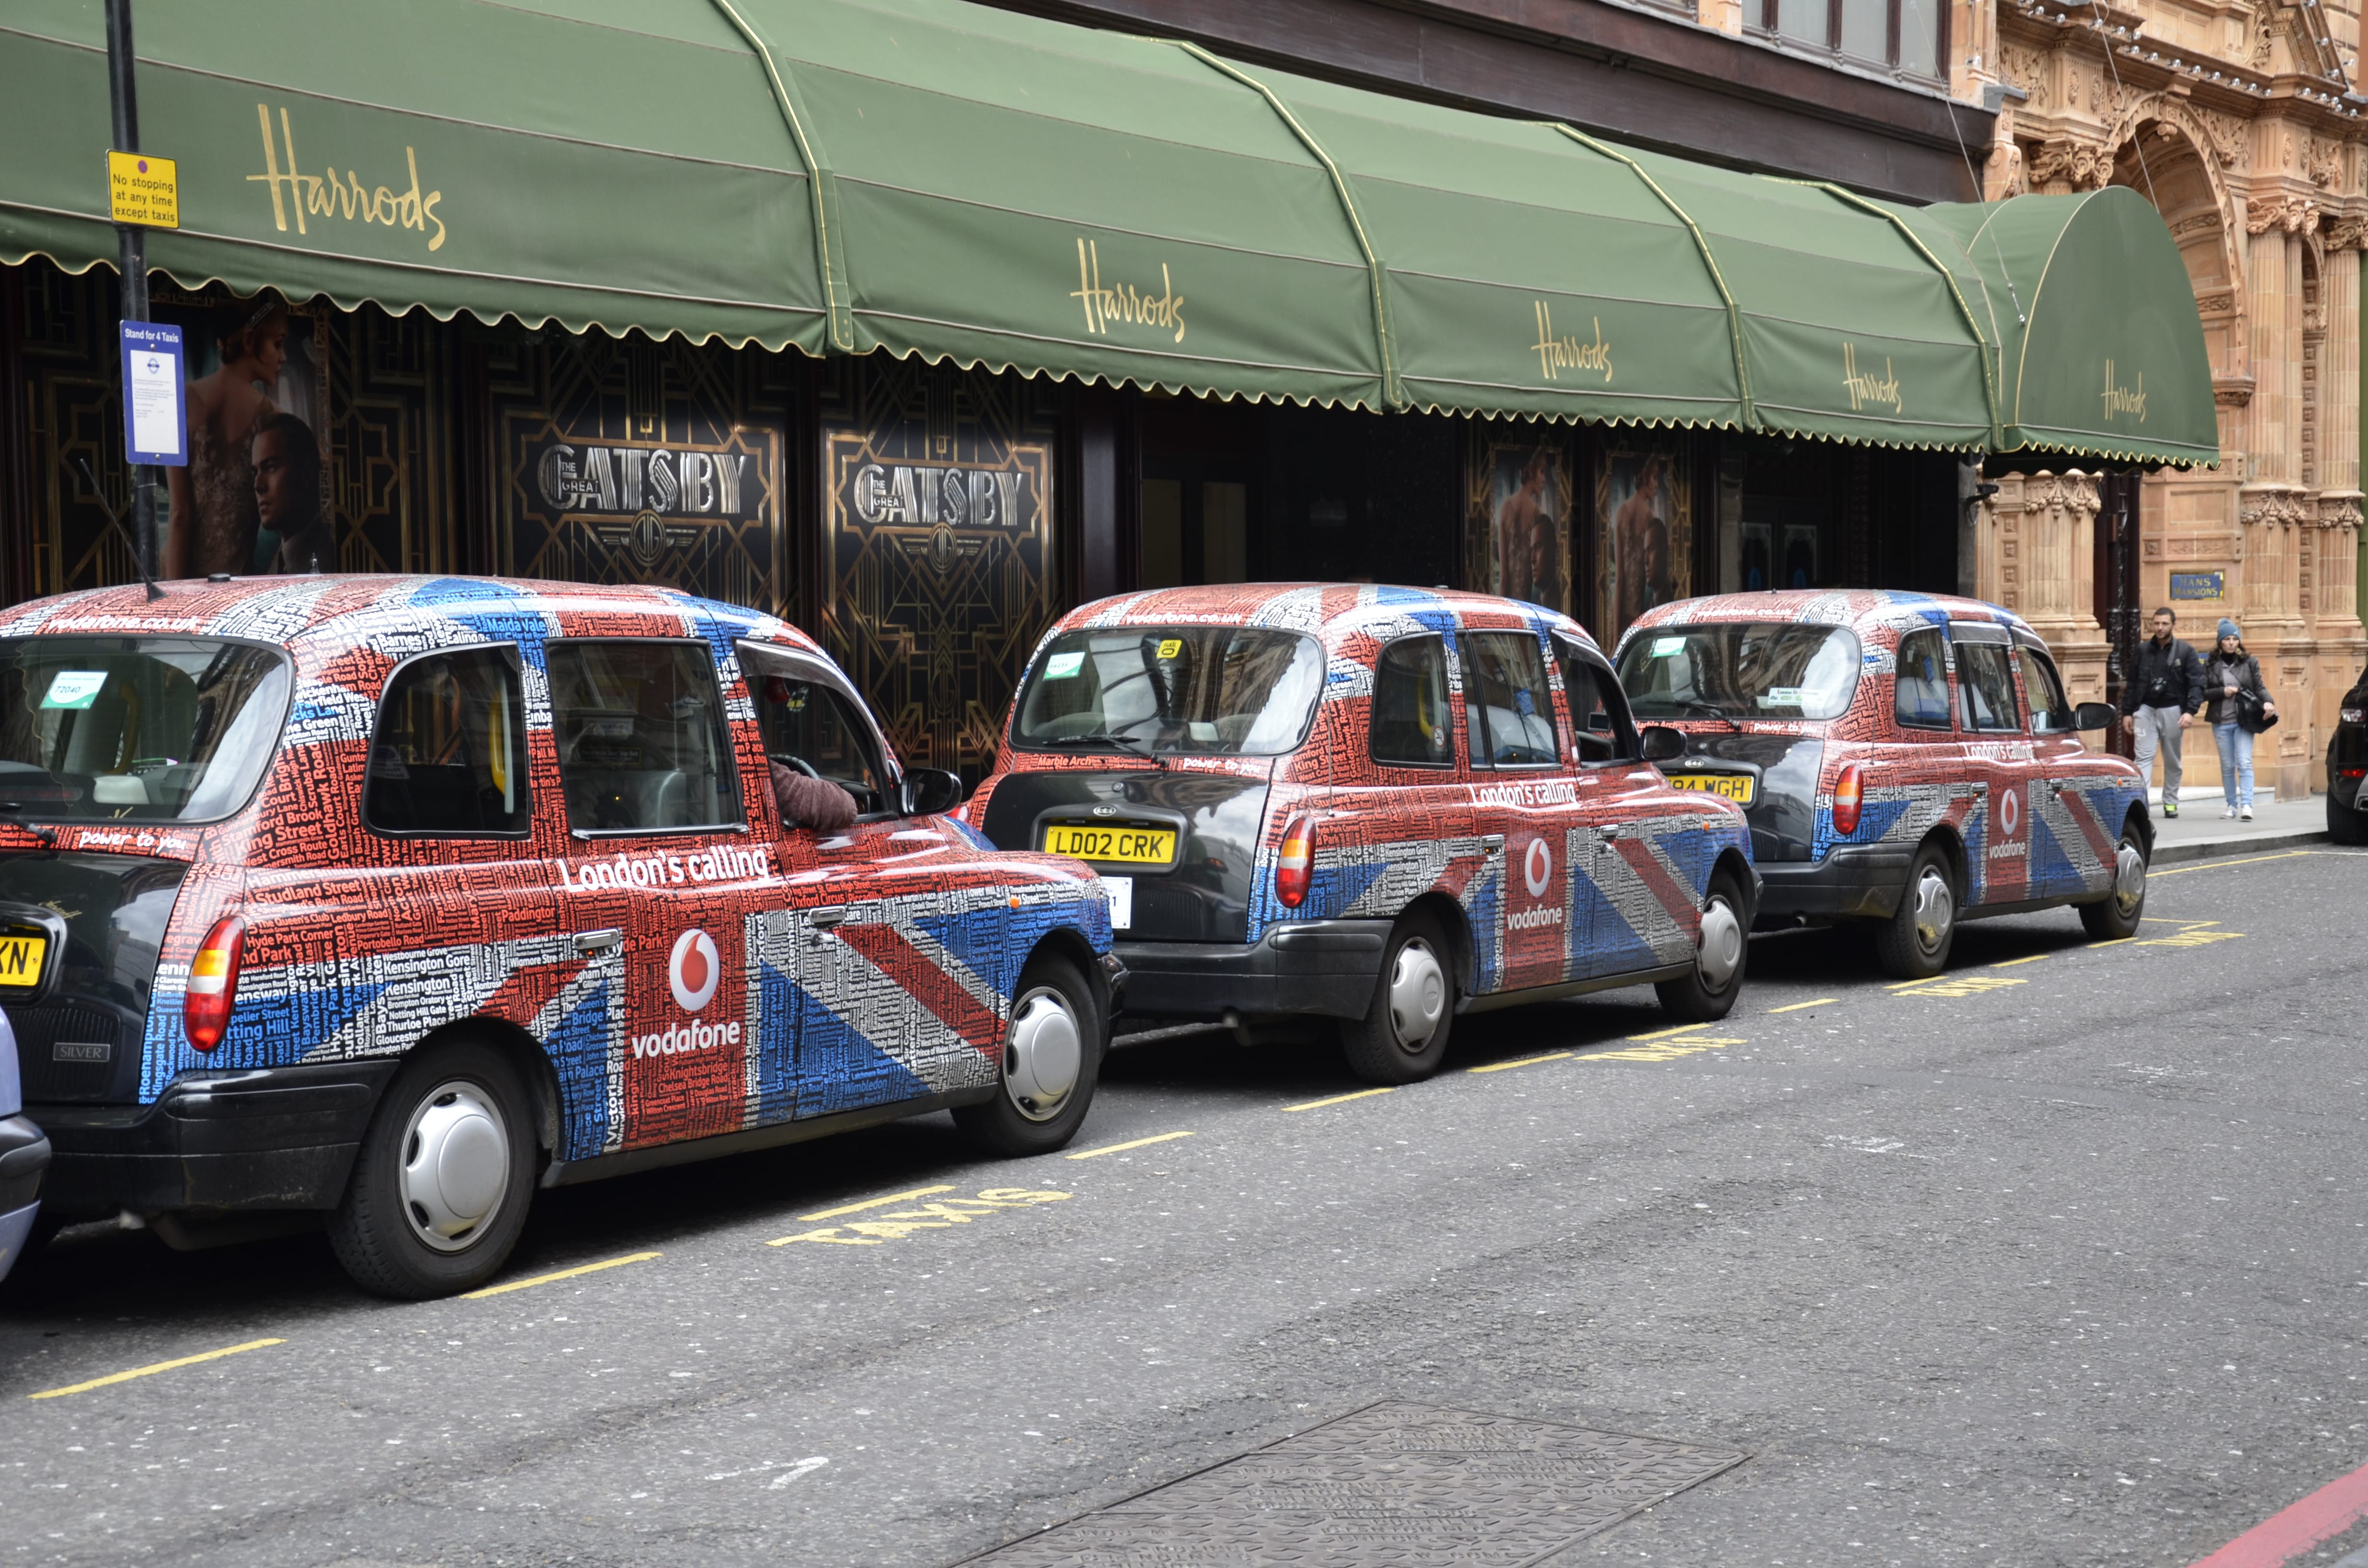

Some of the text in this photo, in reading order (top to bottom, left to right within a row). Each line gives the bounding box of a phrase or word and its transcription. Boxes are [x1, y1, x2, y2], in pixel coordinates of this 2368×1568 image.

[113, 174, 173, 193] No stopping
[246, 103, 445, 251] Harrods
[116, 191, 172, 206] at any time
[115, 207, 174, 221] except taxis
[1070, 238, 1185, 343] Harrods
[125, 328, 179, 343] Stand for 4 Taxis
[1531, 300, 1612, 382] Harrods
[1843, 343, 1902, 414] Harrods
[2101, 358, 2146, 423] Harrods
[562, 462, 576, 473] THE
[537, 444, 747, 513] GATSBY
[874, 479, 885, 489] THE
[562, 481, 599, 493] GREAT
[854, 464, 1023, 526] GATSBY
[874, 497, 903, 508] GREAT
[2180, 577, 2211, 587] HANS
[2174, 587, 2218, 596] MANSIONS
[1126, 613, 1242, 624] vodafone.co.uk
[1697, 608, 1792, 617] vodafone.co.uk
[49, 615, 199, 630] vodafone.co.uk
[486, 618, 546, 632] Maida Vale
[376, 634, 421, 647] Barnes
[445, 632, 478, 645] Ealing
[321, 655, 355, 668] Street
[358, 680, 382, 691] Road
[299, 692, 369, 710] Fairfield West
[317, 705, 346, 717] Lane
[302, 717, 339, 729] Green
[1754, 723, 1817, 734] power to you
[1285, 748, 1324, 764] Stamford
[1962, 741, 2036, 763] London's calling
[1038, 756, 1091, 766] Marble Arch
[1183, 758, 1261, 776] power to you
[1295, 752, 1347, 772] King Street
[261, 792, 296, 808] Court
[310, 744, 339, 859] Goldhawk Road
[1468, 779, 1577, 808] London's calling
[219, 804, 298, 834] Gunnersbury Lane
[221, 809, 323, 845] Stamford Brook
[79, 832, 187, 852] power to you
[234, 822, 323, 856] King Street
[1056, 832, 1164, 858] LD02 CRK
[241, 841, 328, 867] West Cross Route
[1385, 846, 1428, 858] Kensington Gore
[1989, 839, 2025, 859] vodafone
[557, 850, 684, 893] London's
[689, 844, 770, 886] calling
[255, 880, 361, 906] Studland Street
[793, 893, 845, 908] Oxford Circus
[846, 892, 881, 906] Piccadilly
[258, 893, 363, 914] Shepherd's Bush Road
[676, 898, 724, 912] Regent Street
[256, 913, 330, 929] The Queen's Club
[330, 909, 388, 924] Ledbury Road
[502, 906, 555, 922] Paddington
[1507, 904, 1562, 930] vodafone
[246, 930, 333, 950] Hyde Park Corner
[357, 934, 424, 950] Portobello Road
[639, 933, 663, 950] Park
[260, 946, 293, 962] Park
[382, 947, 447, 961] Westbourne Grove
[384, 954, 470, 975] Kensington Gore
[874, 962, 893, 974] Soho
[550, 966, 626, 984] Buckingham Palace
[238, 980, 287, 992] Kensington Road
[385, 978, 450, 996] Kensington
[373, 955, 388, 1035] Bayswater
[387, 996, 444, 1009] Brompton Oratory
[562, 995, 631, 1013] The Queen's Gallery
[261, 1008, 290, 1020] Street
[389, 1005, 446, 1020] Notting Hill Gate
[572, 1007, 632, 1027] Bridge Place
[769, 982, 778, 1050] Belgravia
[962, 1009, 990, 1022] Lambeth
[266, 1018, 290, 1035] Hill
[386, 1016, 446, 1032] Thurloe Place
[376, 1031, 421, 1046] Gloucester
[631, 1018, 740, 1059] vodafone
[61, 1046, 102, 1058] SILVER
[364, 1044, 400, 1056] Kensington
[1572, 1037, 1748, 1062] TAXIS
[670, 1061, 728, 1080] Knightsbridge
[844, 1079, 888, 1095] Wimbledon
[606, 1058, 630, 1144] Victoria Road
[765, 1188, 1074, 1246] TAXIS
